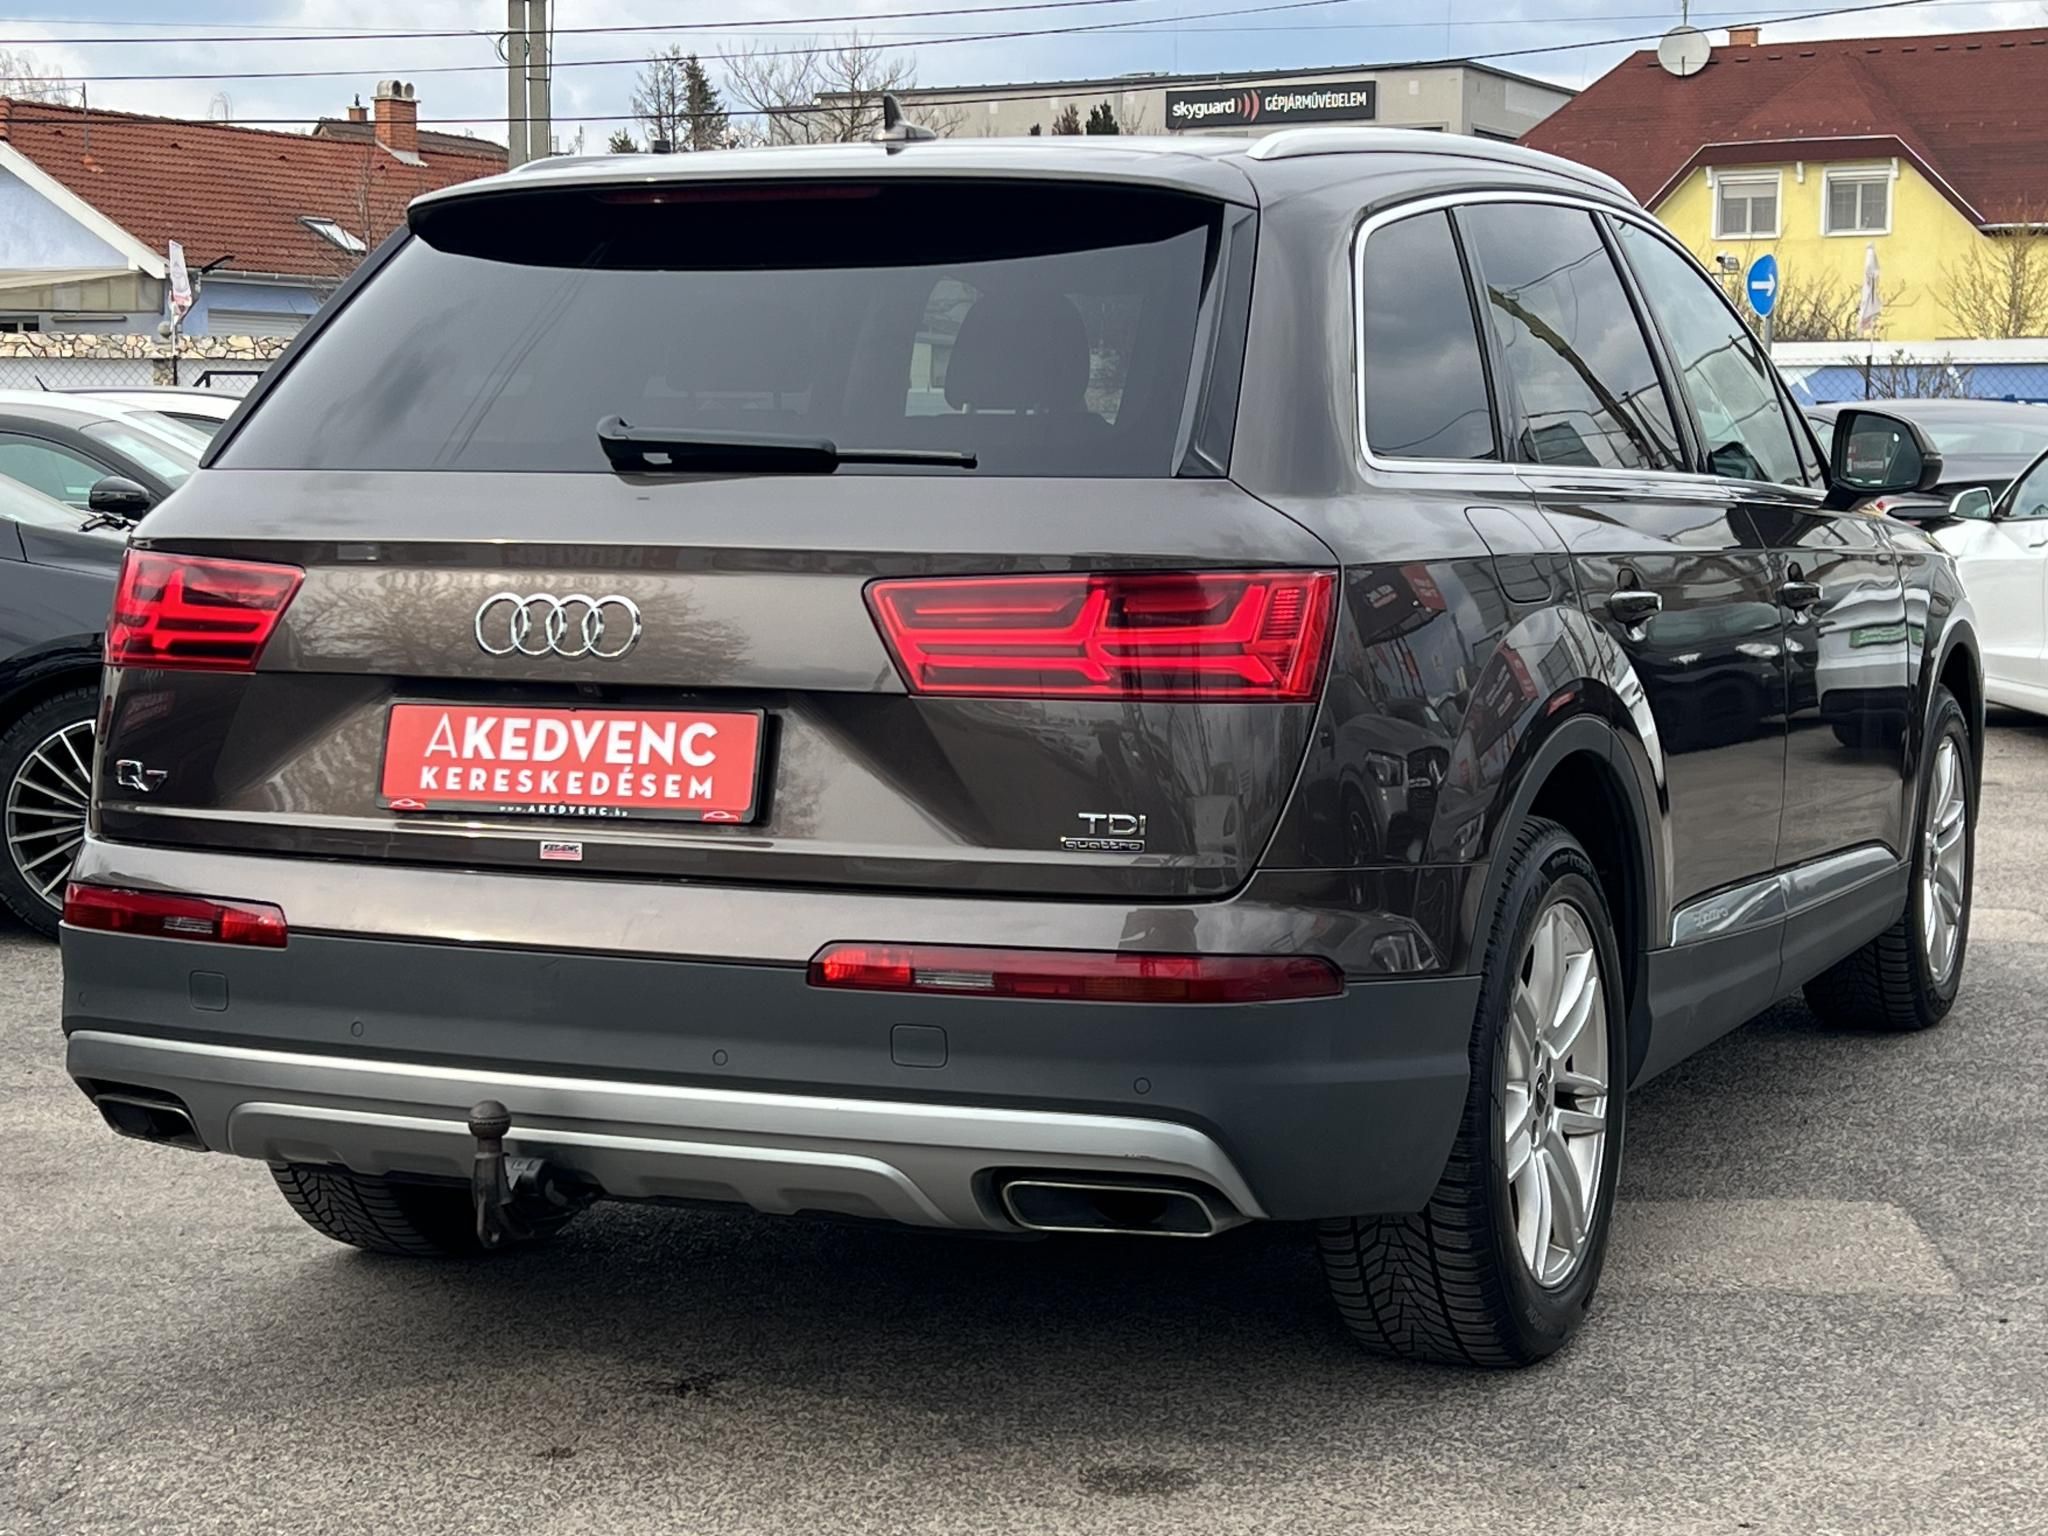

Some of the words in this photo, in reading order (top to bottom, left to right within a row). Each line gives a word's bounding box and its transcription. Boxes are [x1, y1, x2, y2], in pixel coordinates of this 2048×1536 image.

[1172, 98, 1236, 119] skyguard
[1264, 91, 1368, 113] GÉPJÁRMŰVÉDELEM
[424, 712, 718, 767] AKEDVENC
[115, 759, 169, 793] Q7
[419, 765, 714, 800] KERESKEDÉSEM
[1065, 841, 1140, 850] quattro
